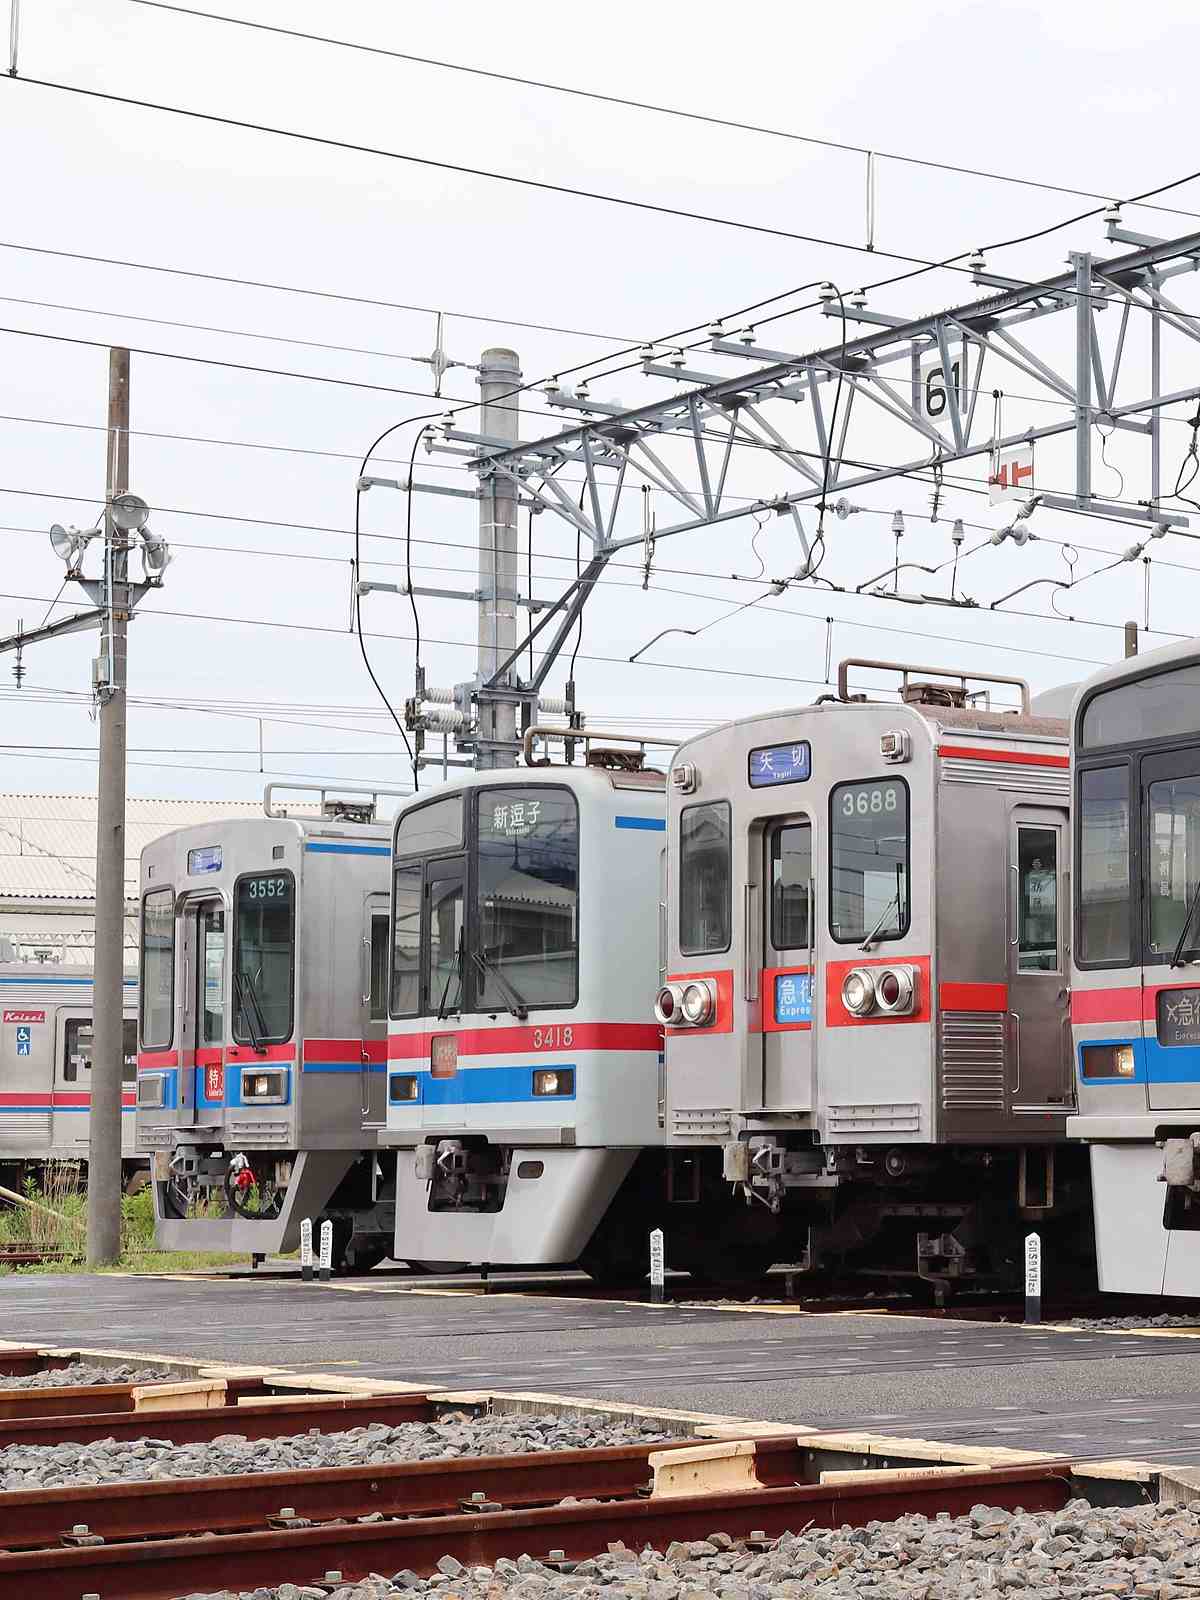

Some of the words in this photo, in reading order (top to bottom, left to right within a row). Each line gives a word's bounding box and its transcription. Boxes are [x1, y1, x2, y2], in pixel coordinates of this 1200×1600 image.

[926, 361, 960, 416] 61
[842, 788, 898, 816] 3688
[493, 801, 541, 830] 新逗子
[249, 879, 286, 899] 3552
[4, 1012, 43, 1022] Keisei
[534, 1026, 573, 1049] 3418
